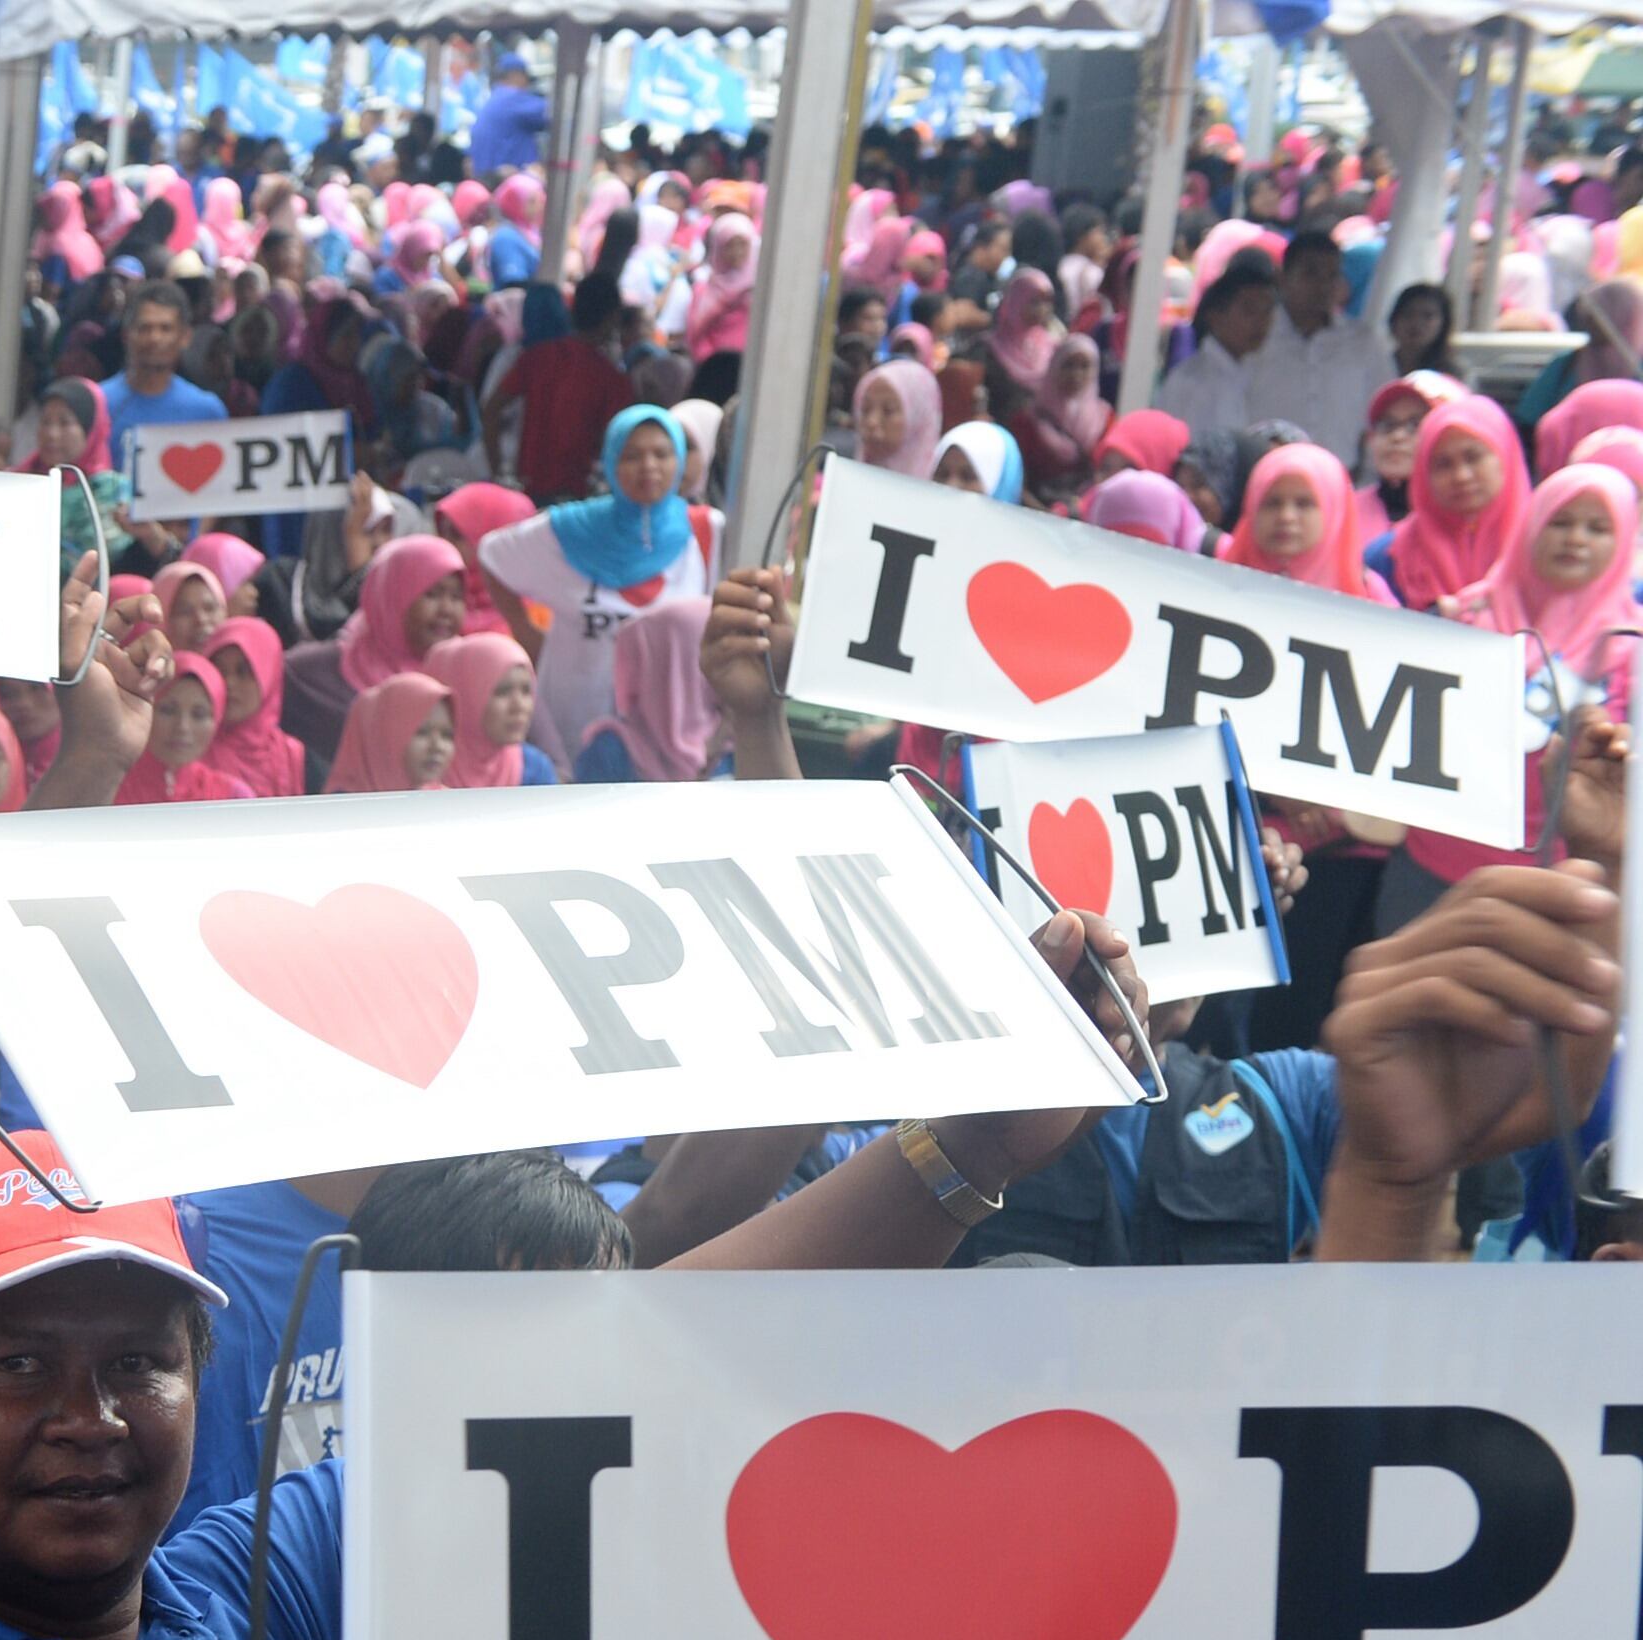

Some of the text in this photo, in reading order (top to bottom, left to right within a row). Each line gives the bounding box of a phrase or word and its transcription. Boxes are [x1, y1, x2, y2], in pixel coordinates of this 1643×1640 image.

[235, 433, 349, 492] PM
[847, 524, 1463, 792] I PM
[1112, 779, 1267, 947] PM
[8, 853, 1012, 1113] I PM
